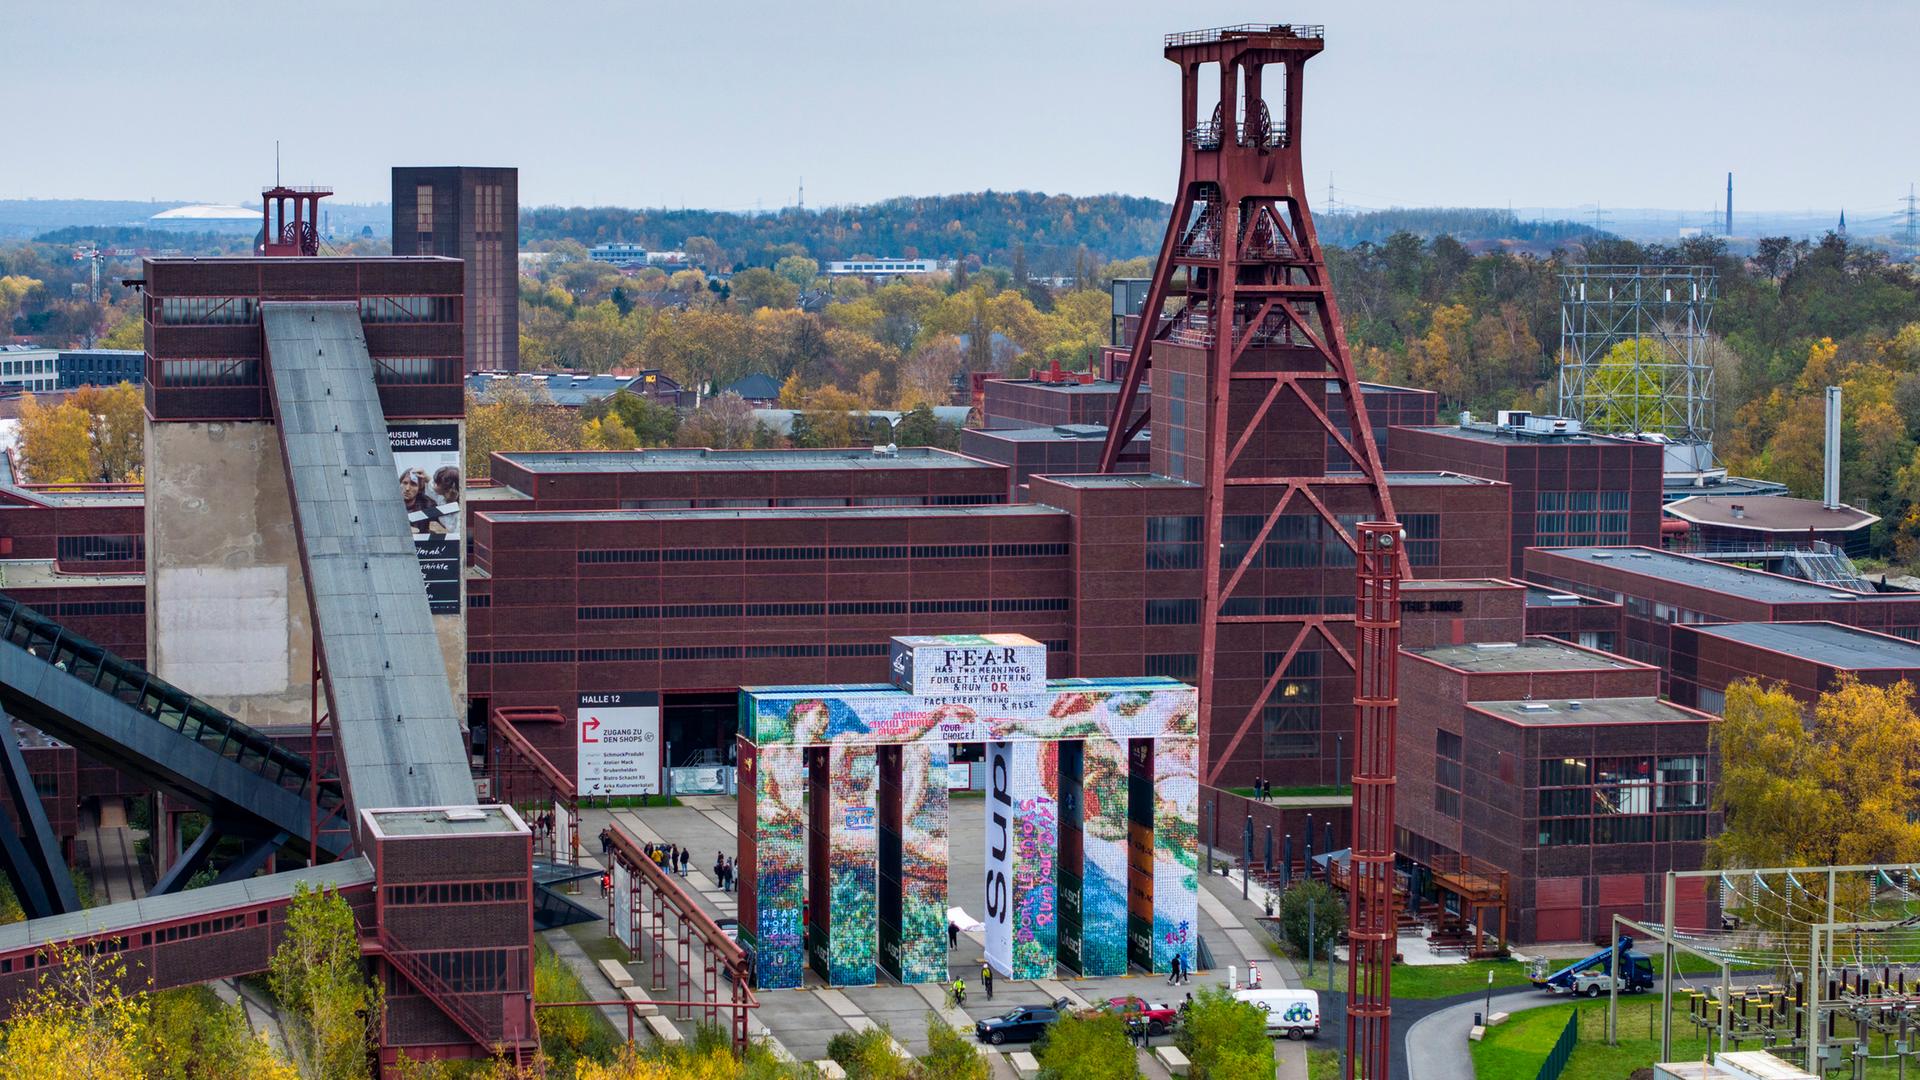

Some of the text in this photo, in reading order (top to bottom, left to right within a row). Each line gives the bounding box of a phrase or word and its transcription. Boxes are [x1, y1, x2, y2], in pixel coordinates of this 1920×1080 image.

[387, 431, 419, 439] MUSEUM
[390, 437, 452, 446] KOHLENWÄSCHE
[930, 673, 1032, 684] FORGET EVERYTHING
[991, 682, 1009, 692] OR
[582, 695, 621, 704] HALLE 12
[924, 697, 947, 706] FACE
[940, 723, 960, 732] YOUR
[603, 735, 643, 744] DEN SHOPS
